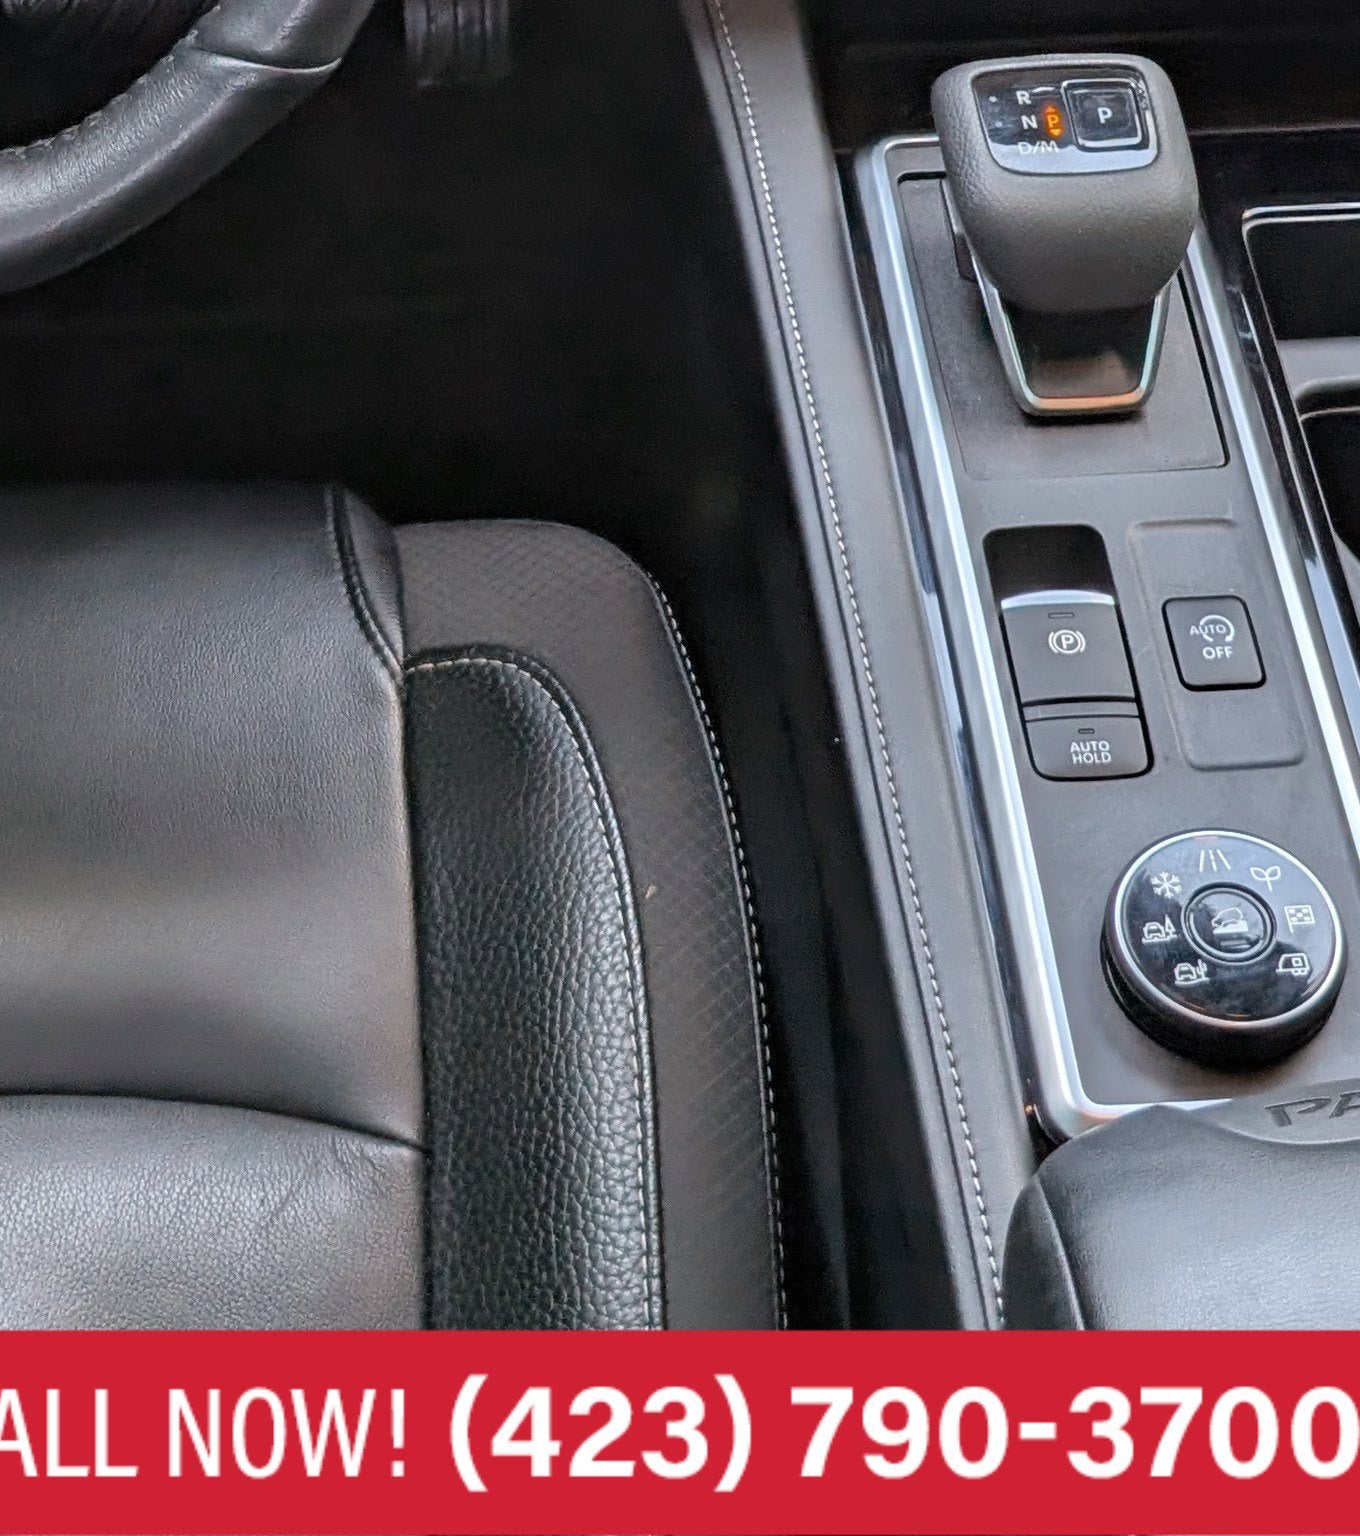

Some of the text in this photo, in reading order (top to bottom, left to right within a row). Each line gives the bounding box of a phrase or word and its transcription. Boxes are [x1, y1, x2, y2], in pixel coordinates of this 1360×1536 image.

[1016, 90, 1031, 105] R
[1047, 115, 1059, 127] P
[1098, 107, 1113, 124] P
[1021, 115, 1038, 130] N
[1017, 140, 1059, 155] D/M
[1190, 624, 1226, 636] AUTO
[1202, 646, 1233, 659] OFF
[1070, 740, 1110, 753] AUTO
[1072, 752, 1112, 764] HOLD
